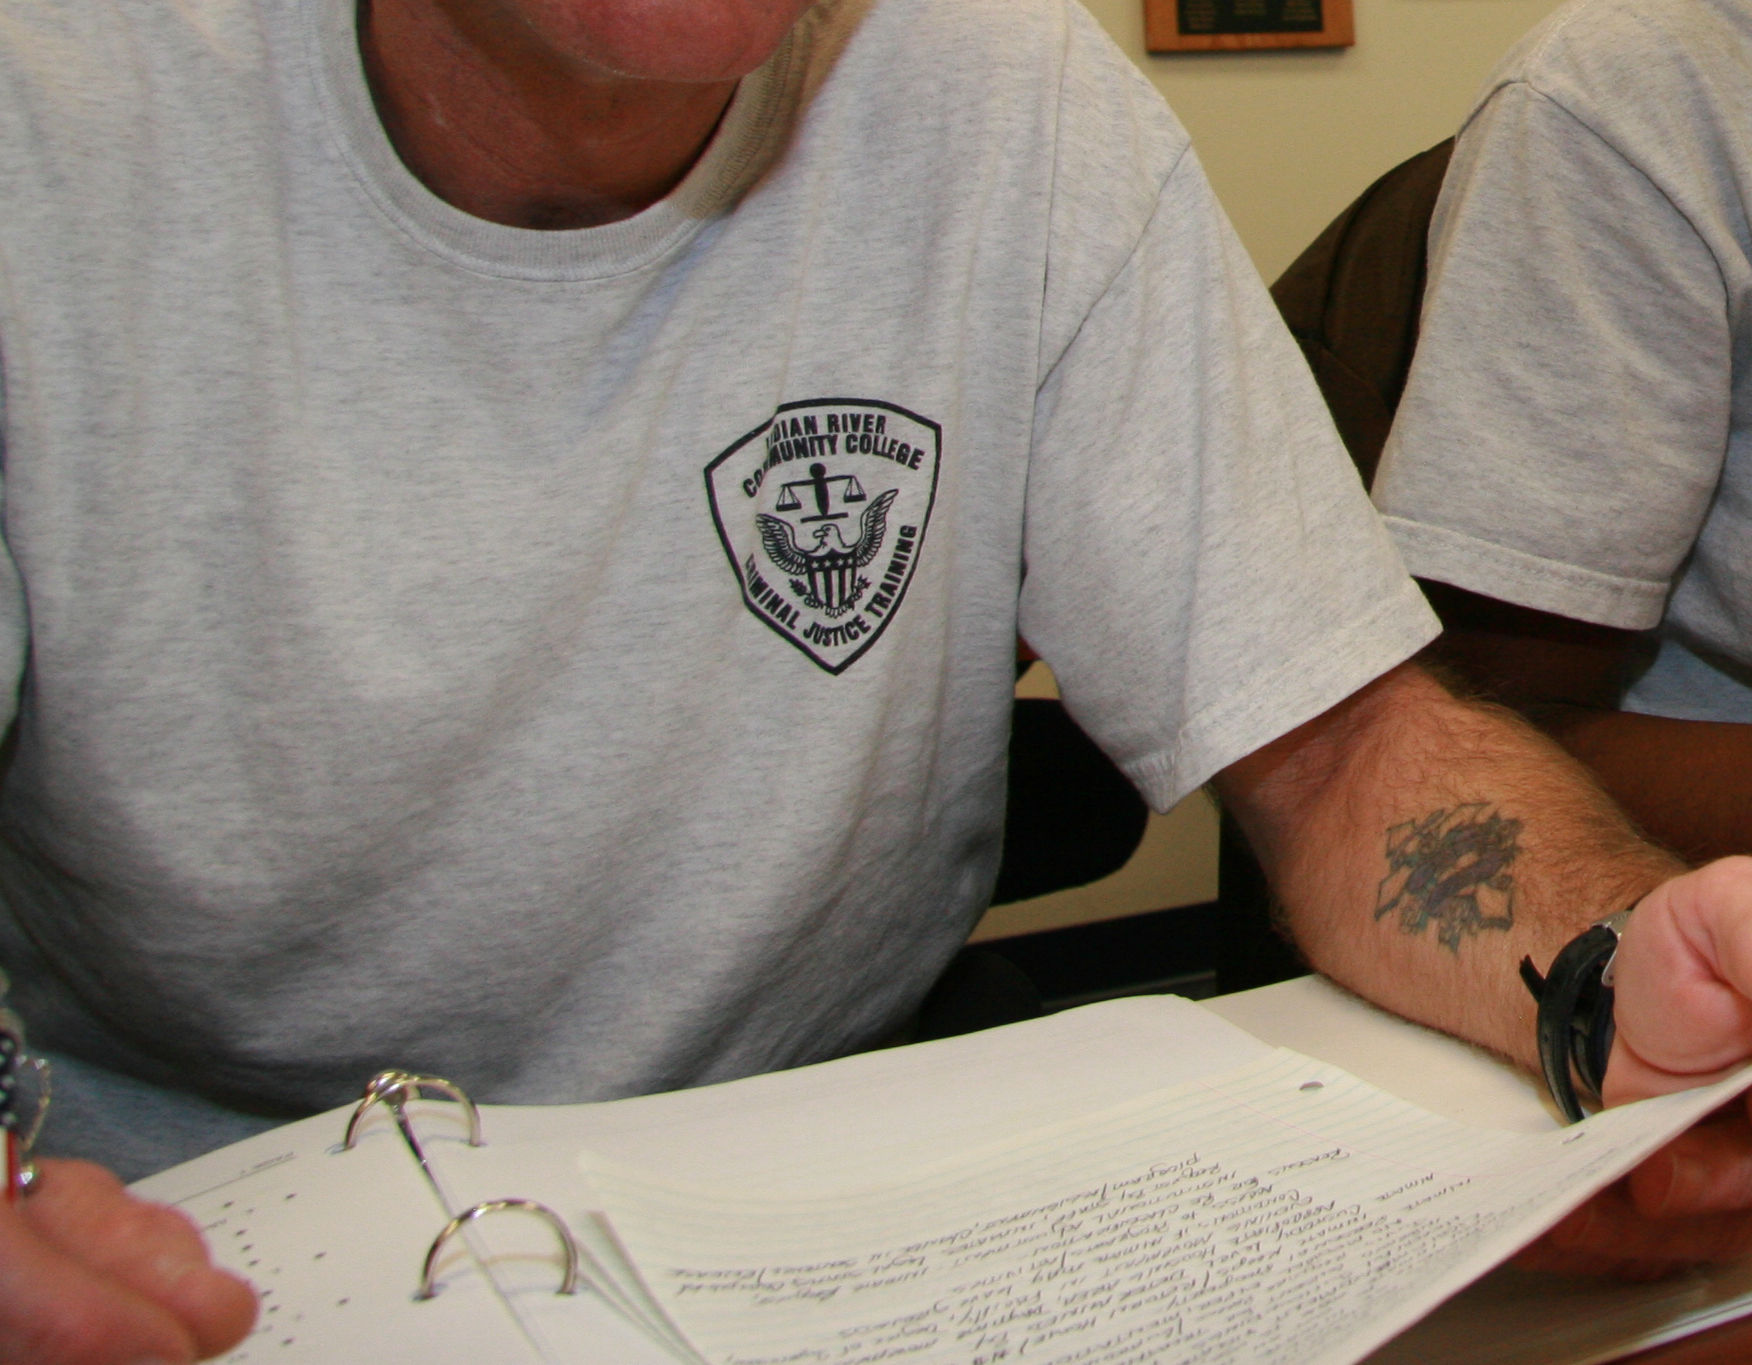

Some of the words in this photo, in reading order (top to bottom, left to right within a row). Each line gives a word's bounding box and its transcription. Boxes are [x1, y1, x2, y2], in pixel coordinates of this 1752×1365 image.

[766, 416, 818, 449] IDIAN
[827, 413, 887, 435] RIVER
[846, 433, 926, 470] COLLEGE
[803, 615, 872, 647] JUSTICE
[864, 525, 918, 618] TRAINING
